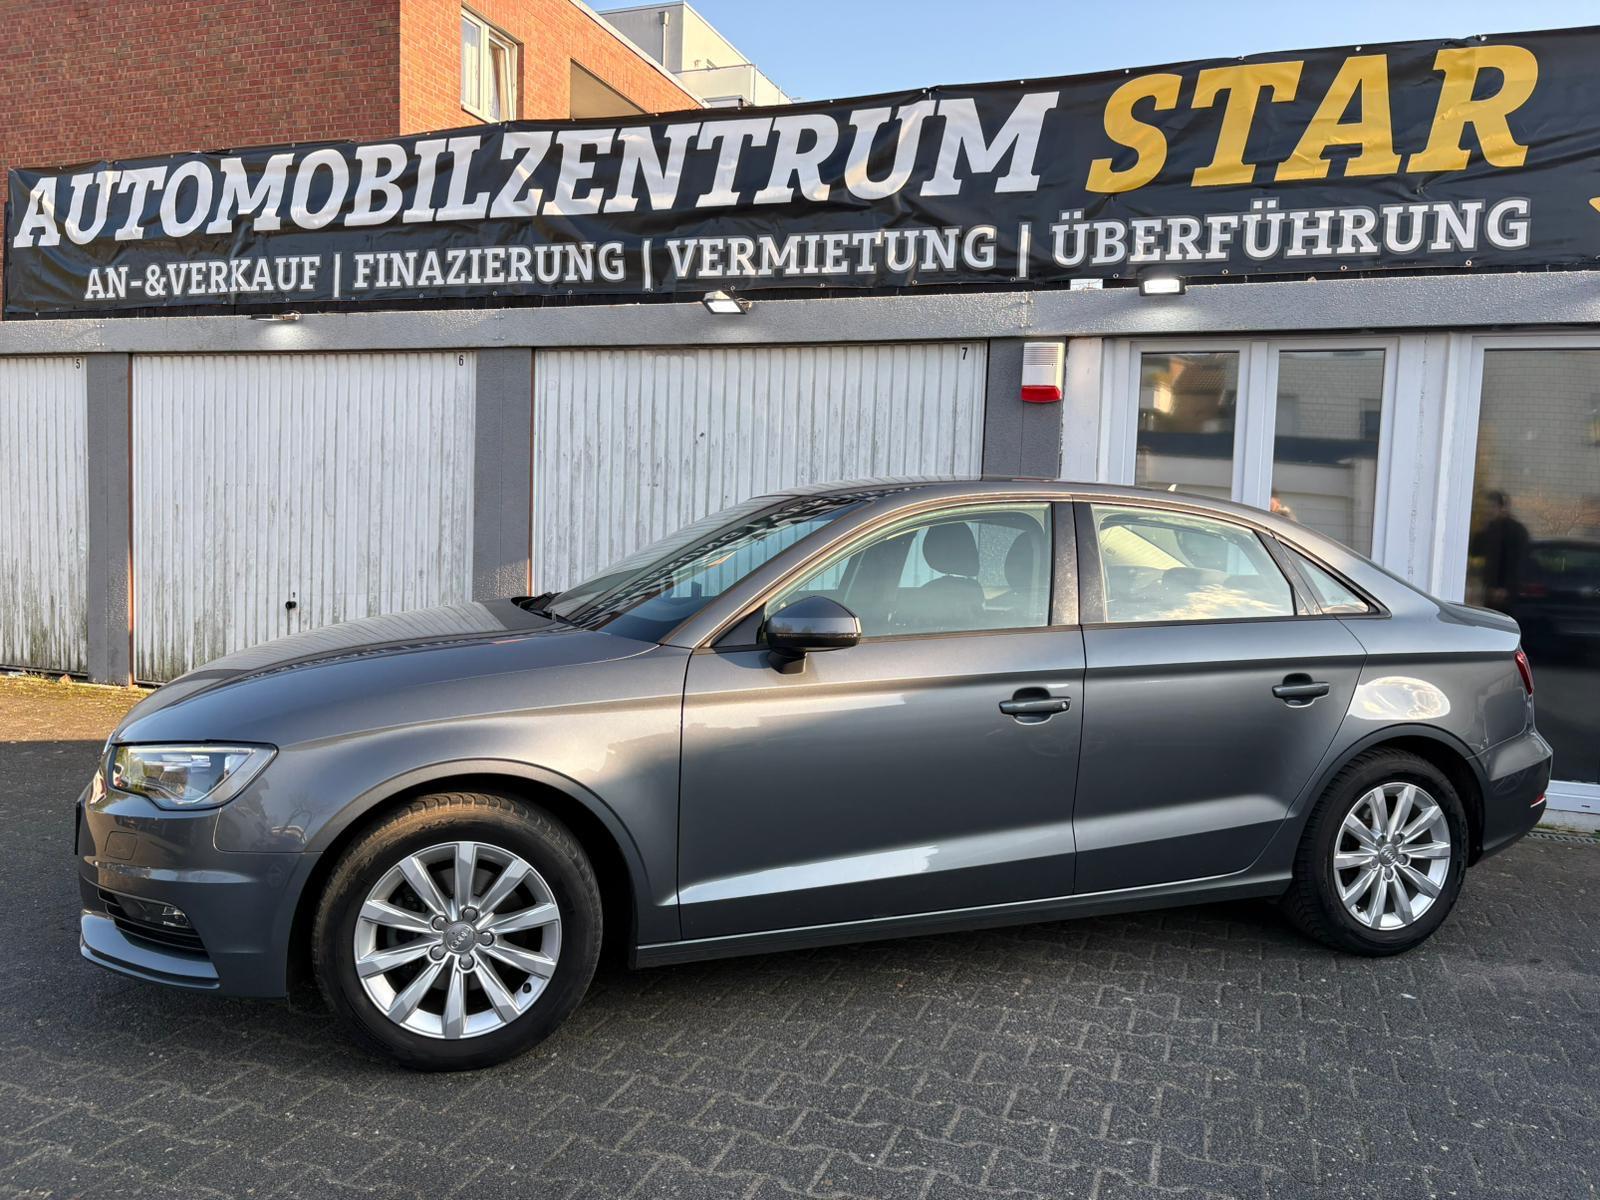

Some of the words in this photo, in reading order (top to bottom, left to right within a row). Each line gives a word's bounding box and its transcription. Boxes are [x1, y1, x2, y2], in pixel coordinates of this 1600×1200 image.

[13, 90, 1060, 249] AUTOMOBILZENTRUM
[1085, 45, 1539, 193] STAR
[84, 255, 322, 300] AN-&VERKAUF
[354, 242, 625, 289] FINAZIERUNG
[666, 226, 997, 279] VERMIETUNG
[1051, 198, 1529, 266] ÜBERFÜHRUNG
[962, 347, 968, 360] 7
[75, 358, 81, 369] 5
[458, 354, 464, 367] 6
